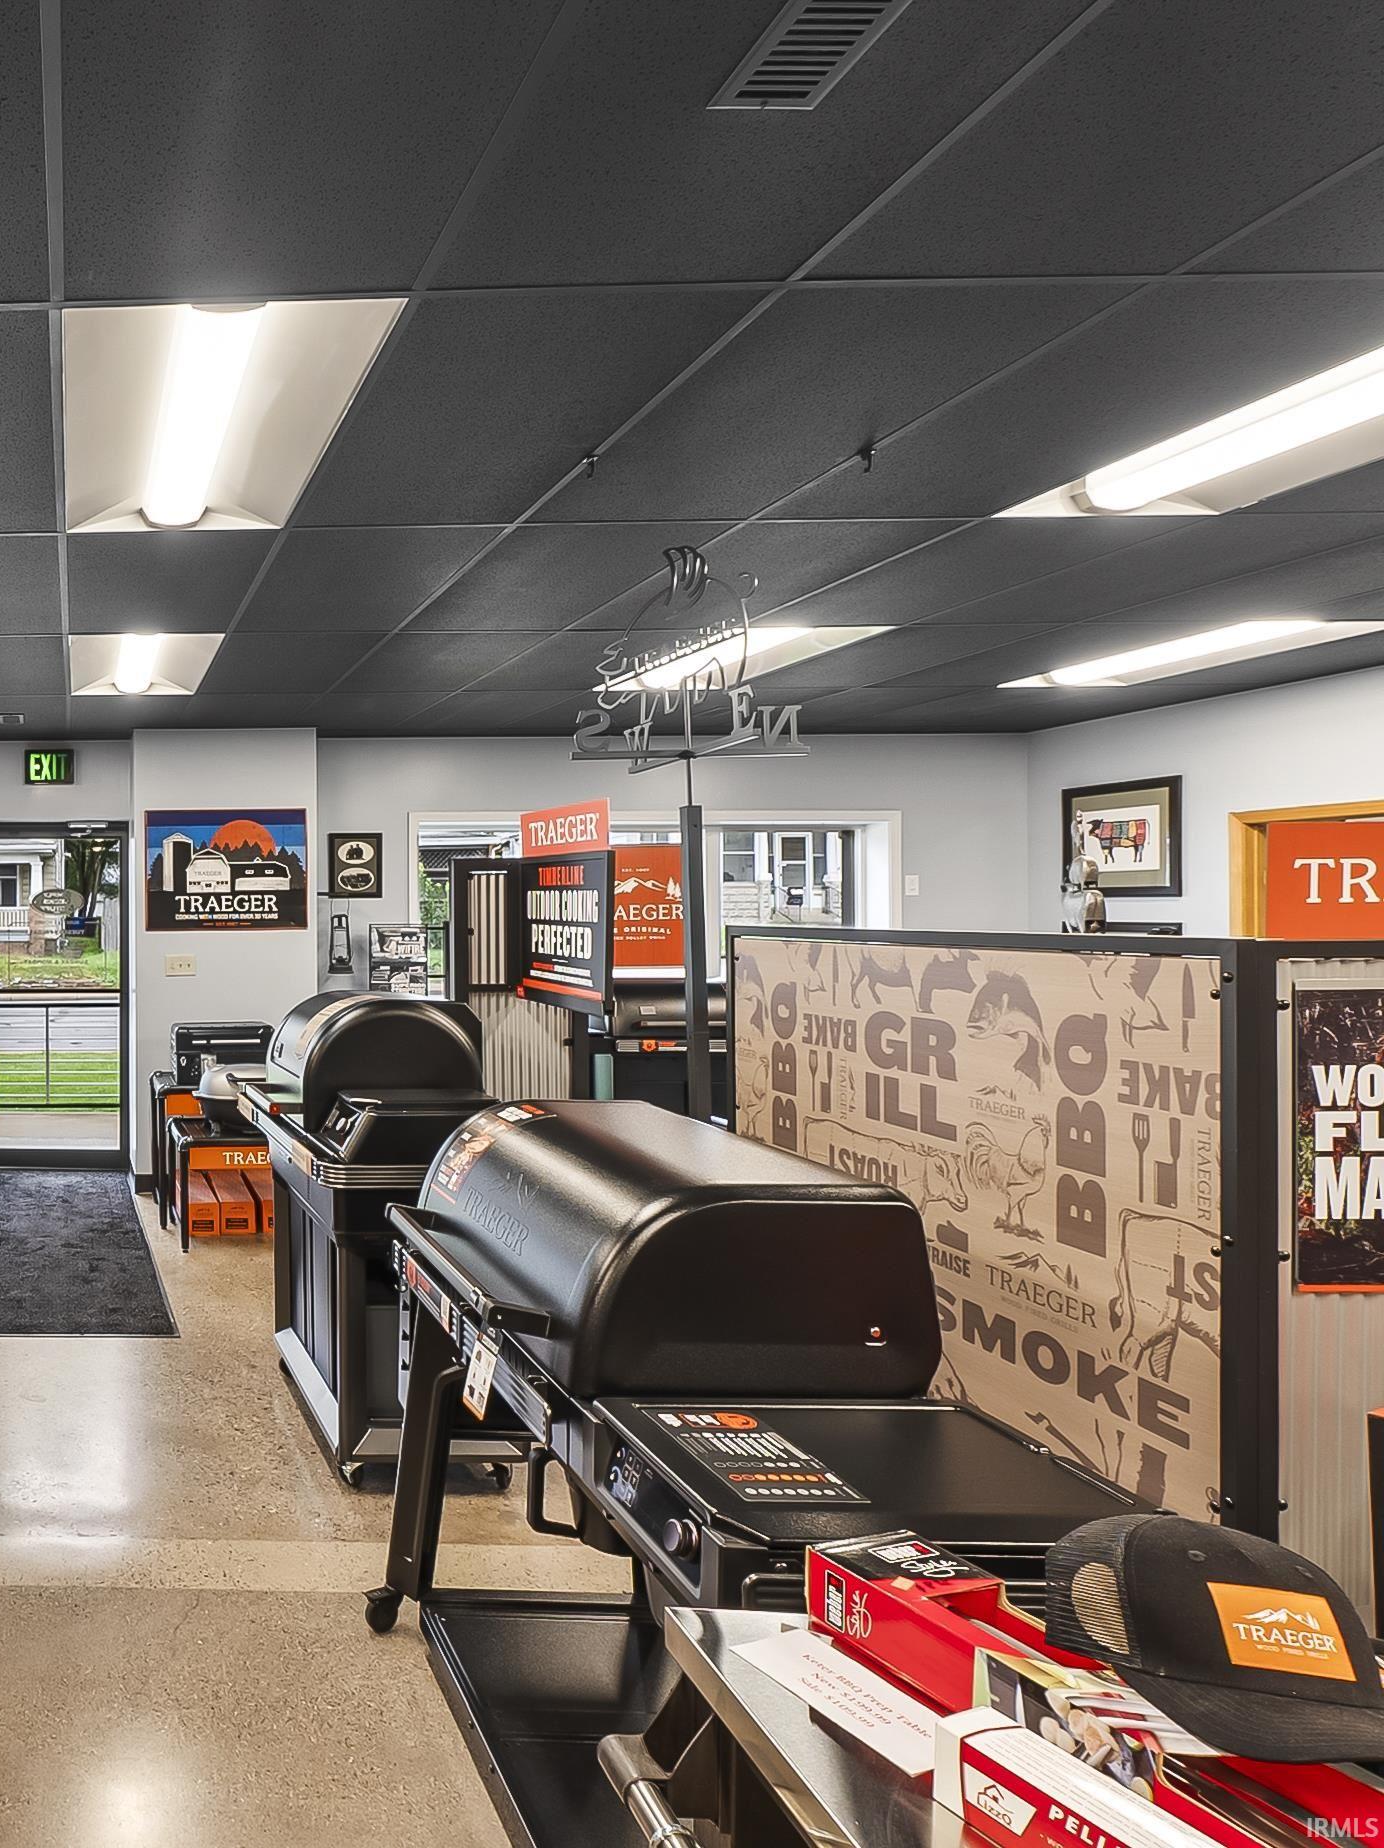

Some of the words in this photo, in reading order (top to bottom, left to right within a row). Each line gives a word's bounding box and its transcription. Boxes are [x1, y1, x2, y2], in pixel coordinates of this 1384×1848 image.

[30, 754, 68, 780] EXIT
[529, 813, 599, 847] TRAEGER
[538, 865, 585, 887] TIMBERLINE
[1293, 858, 1384, 903] TR
[175, 895, 278, 912] TRAEGER
[526, 890, 560, 921] OUTDOOR
[561, 890, 598, 923] COOKING
[613, 904, 684, 920] AEGER
[531, 924, 593, 959] PERFECTED
[623, 926, 672, 935] ORIGINAL
[802, 1014, 857, 1053] BAKE
[865, 1011, 958, 1081] GR
[771, 981, 797, 1152] BBQ
[866, 1072, 957, 1142] ILL
[968, 1096, 1026, 1120] TRAEGER
[1053, 1013, 1108, 1258] BBQ
[223, 1152, 271, 1164] TRAE
[1197, 1127, 1212, 1221] TRAEGER
[461, 1187, 530, 1256] TRAEGER
[929, 1246, 971, 1279] RAISE
[985, 1264, 1097, 1328] TRAEGER
[936, 1286, 1190, 1449] SMOKE
[874, 1545, 922, 1562] weber
[828, 1584, 843, 1628] weber
[1232, 1623, 1337, 1653] TRAEGER
[798, 1677, 823, 1693] Sale
[802, 1654, 835, 1679] Keter
[835, 1674, 863, 1695] BBQ
[863, 1693, 894, 1714] Prep
[896, 1714, 933, 1740] Table
[811, 1672, 839, 1690] New
[1048, 1804, 1124, 1848] PELL
